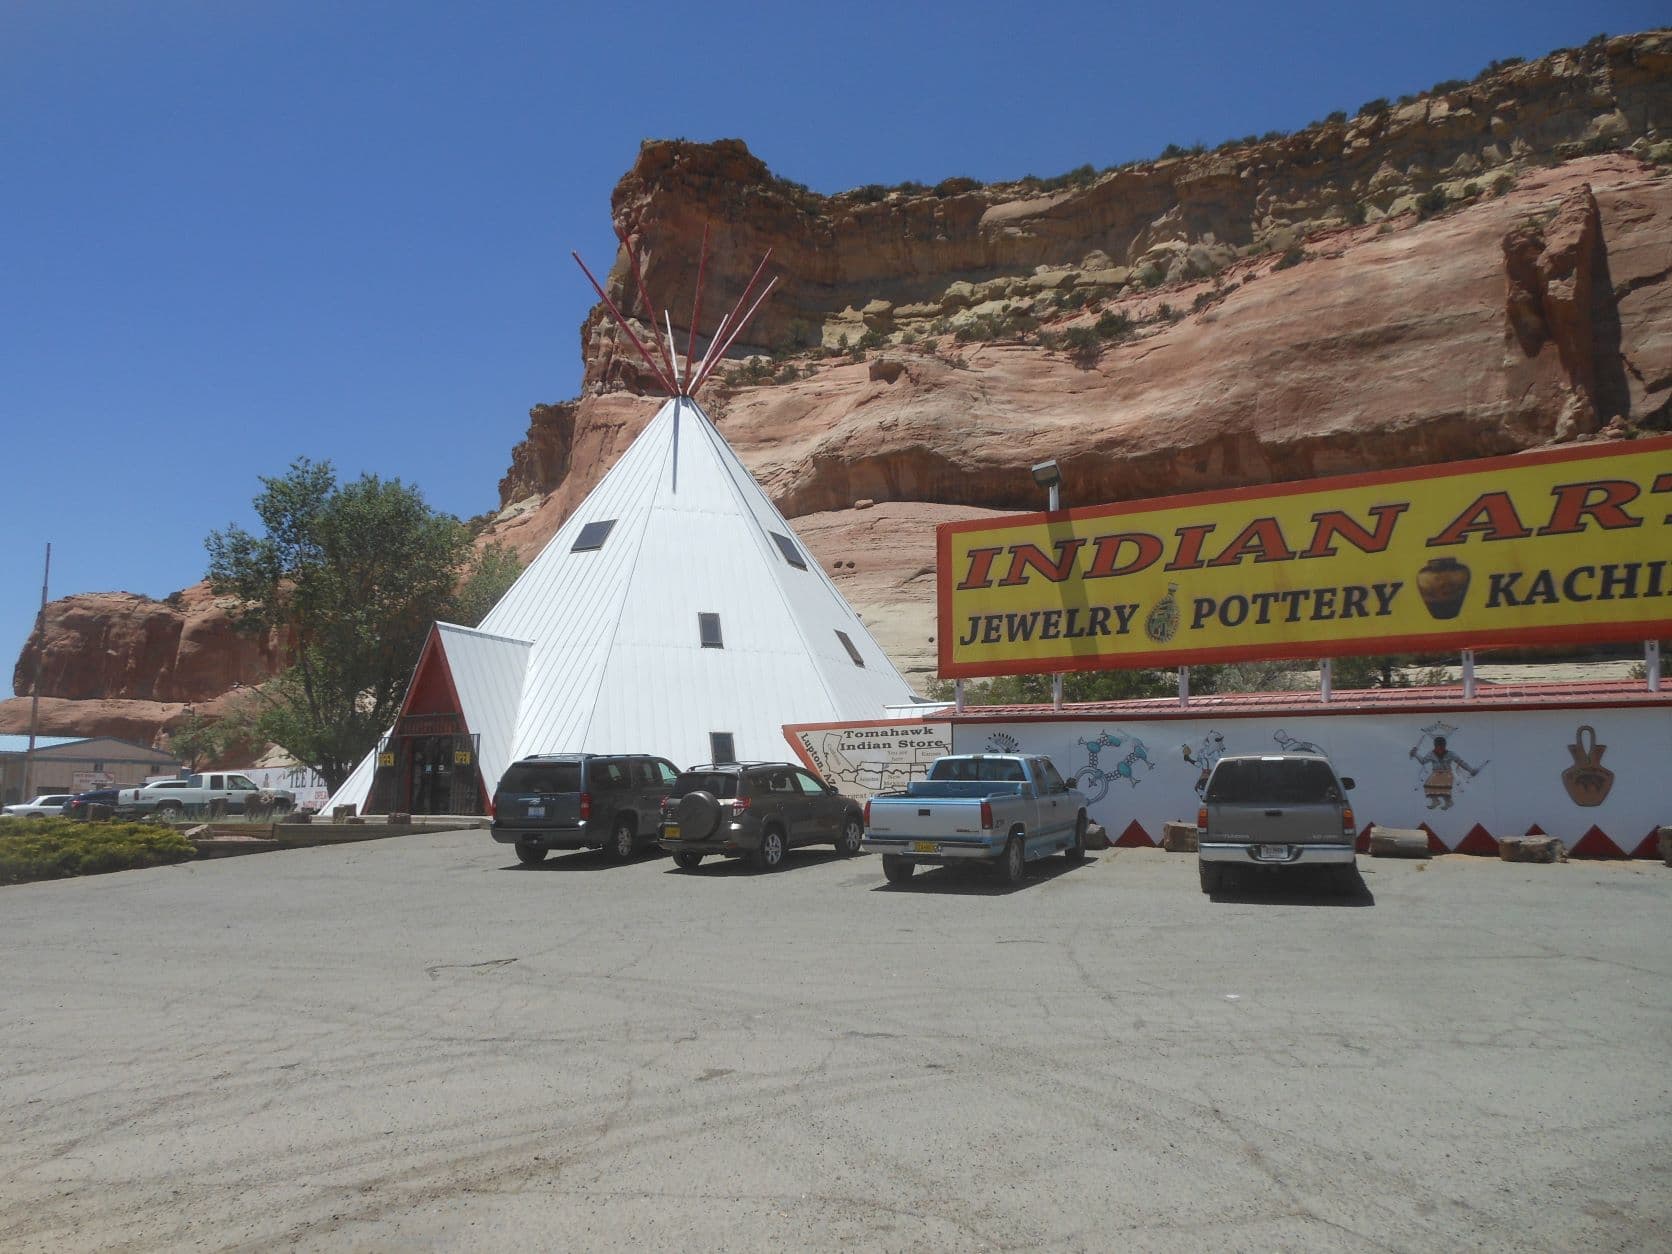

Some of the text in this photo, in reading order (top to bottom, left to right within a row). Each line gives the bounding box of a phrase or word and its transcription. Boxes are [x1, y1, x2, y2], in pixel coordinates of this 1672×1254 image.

[956, 502, 1410, 591] INDIAN
[959, 560, 1672, 646] JEWELRY POTTERY KACHI
[801, 732, 824, 773] Lupton,
[840, 739, 945, 751] Indian Store
[843, 726, 934, 738] Tomahawk
